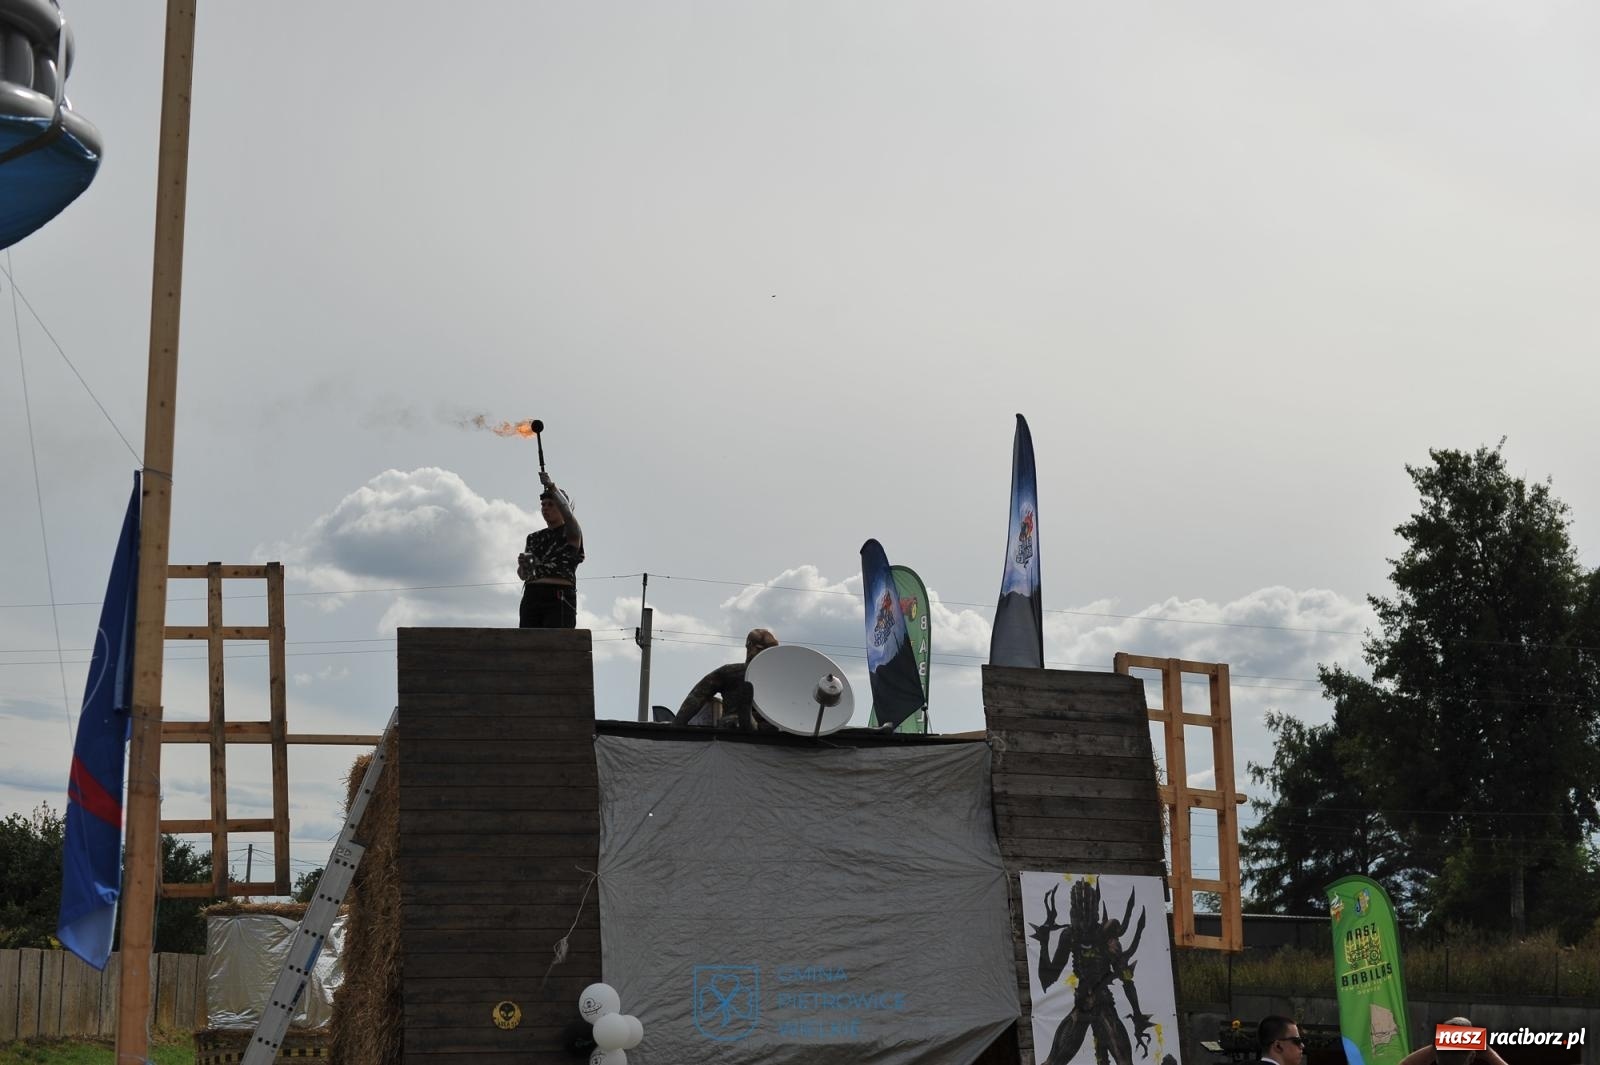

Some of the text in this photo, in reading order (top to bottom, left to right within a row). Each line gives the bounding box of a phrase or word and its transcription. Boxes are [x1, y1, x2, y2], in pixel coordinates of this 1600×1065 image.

[1347, 923, 1376, 941] NASZ
[777, 965, 848, 983] GMINA
[1342, 963, 1392, 986] BABILAS
[778, 991, 905, 1009] PIETROWICE
